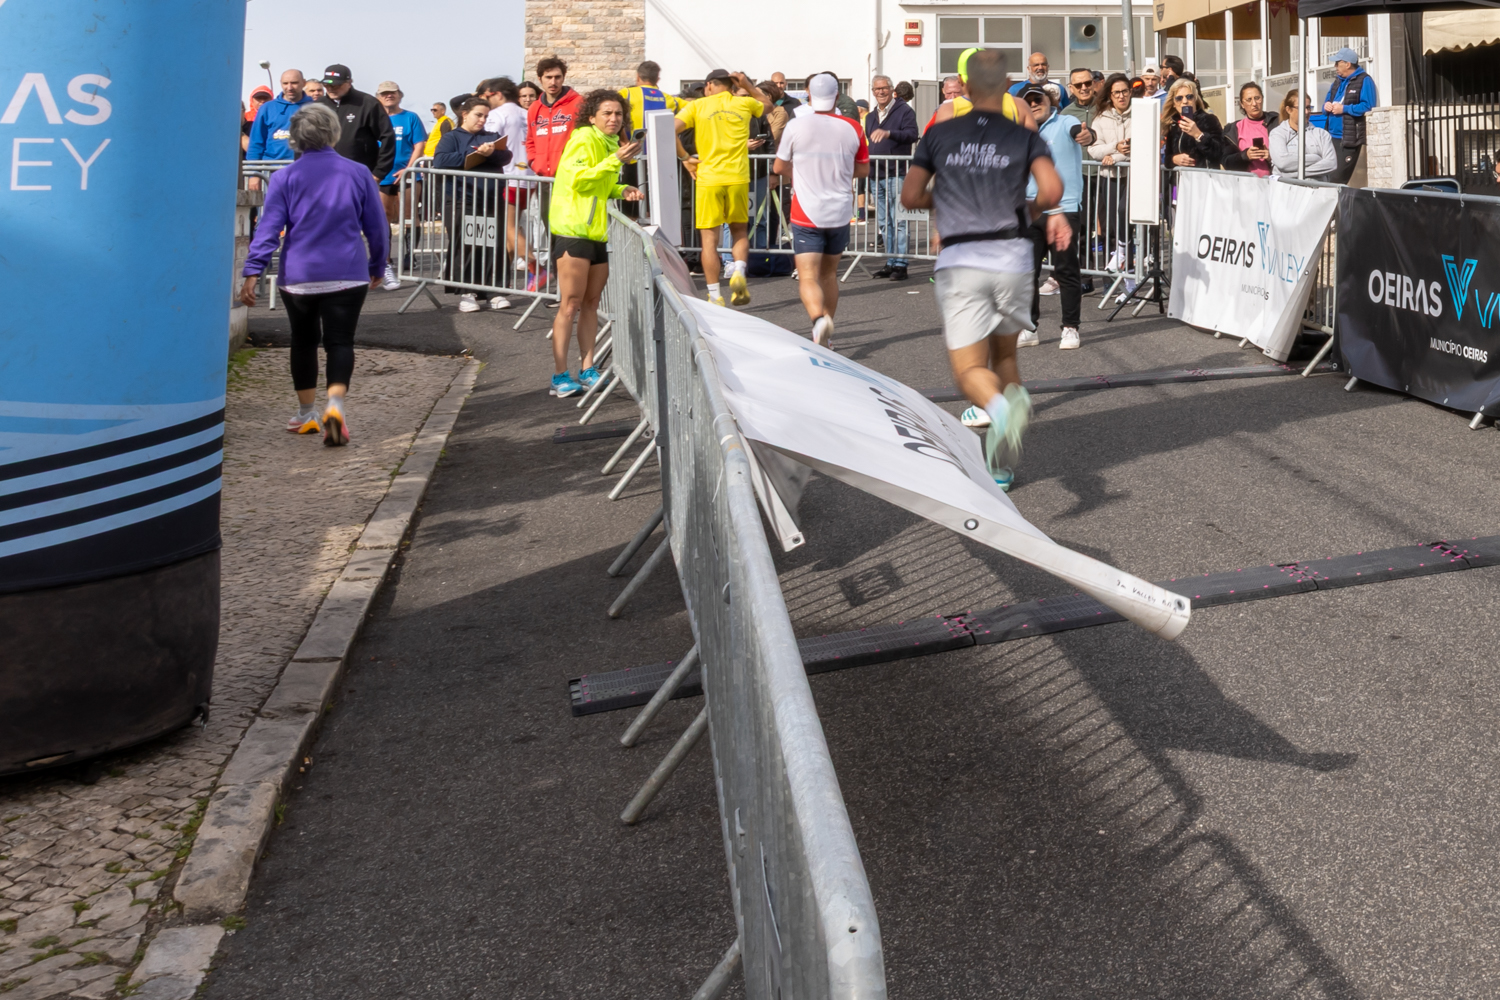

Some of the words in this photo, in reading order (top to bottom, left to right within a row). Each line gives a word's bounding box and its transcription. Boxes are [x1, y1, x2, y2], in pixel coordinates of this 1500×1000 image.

[945, 152, 973, 167] AND
[974, 153, 1010, 169] VIBES
[960, 141, 997, 156] MILES
[1197, 233, 1256, 269] OEIRAS
[1368, 268, 1443, 318] OEIRAS
[1429, 336, 1463, 357] MUNICÍPIO
[1462, 345, 1488, 364] OEIRAS
